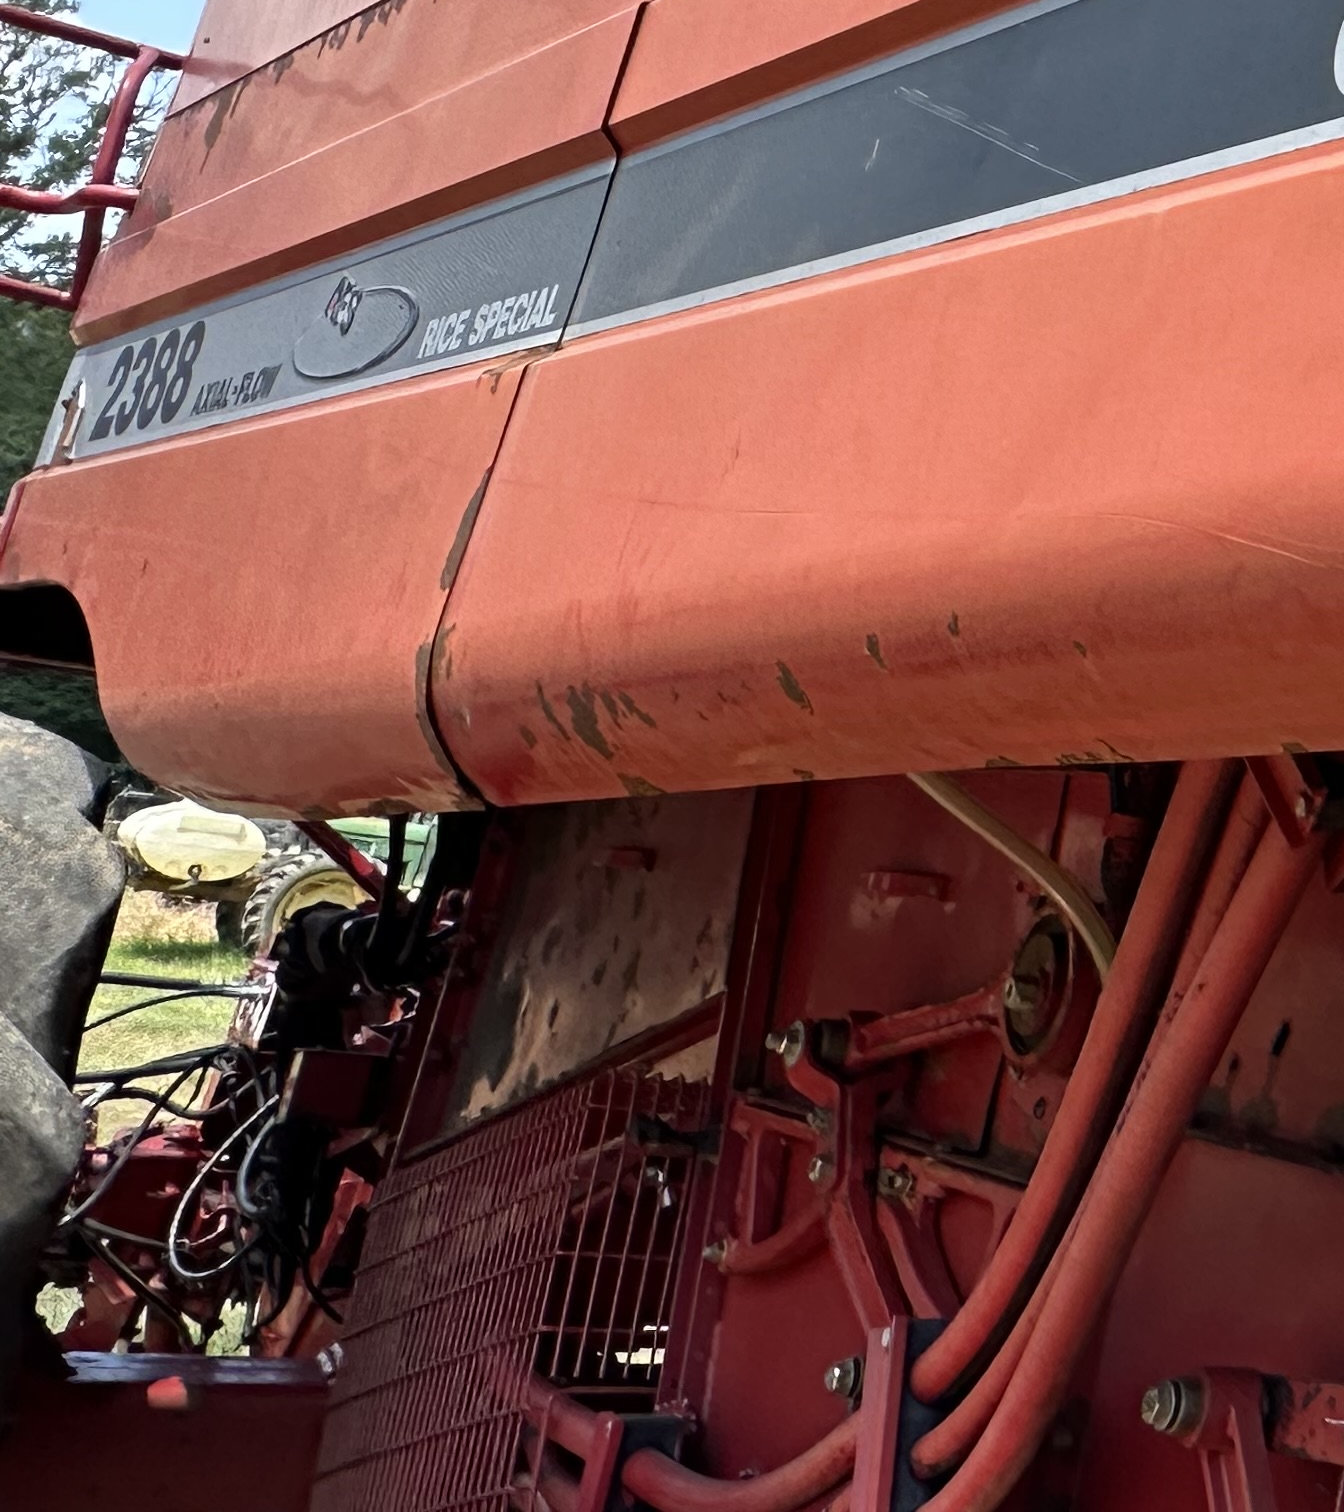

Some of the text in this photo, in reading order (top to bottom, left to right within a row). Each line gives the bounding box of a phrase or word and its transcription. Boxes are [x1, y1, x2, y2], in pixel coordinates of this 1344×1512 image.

[416, 284, 559, 359] RICE SPECIAL
[87, 320, 206, 441] 2388
